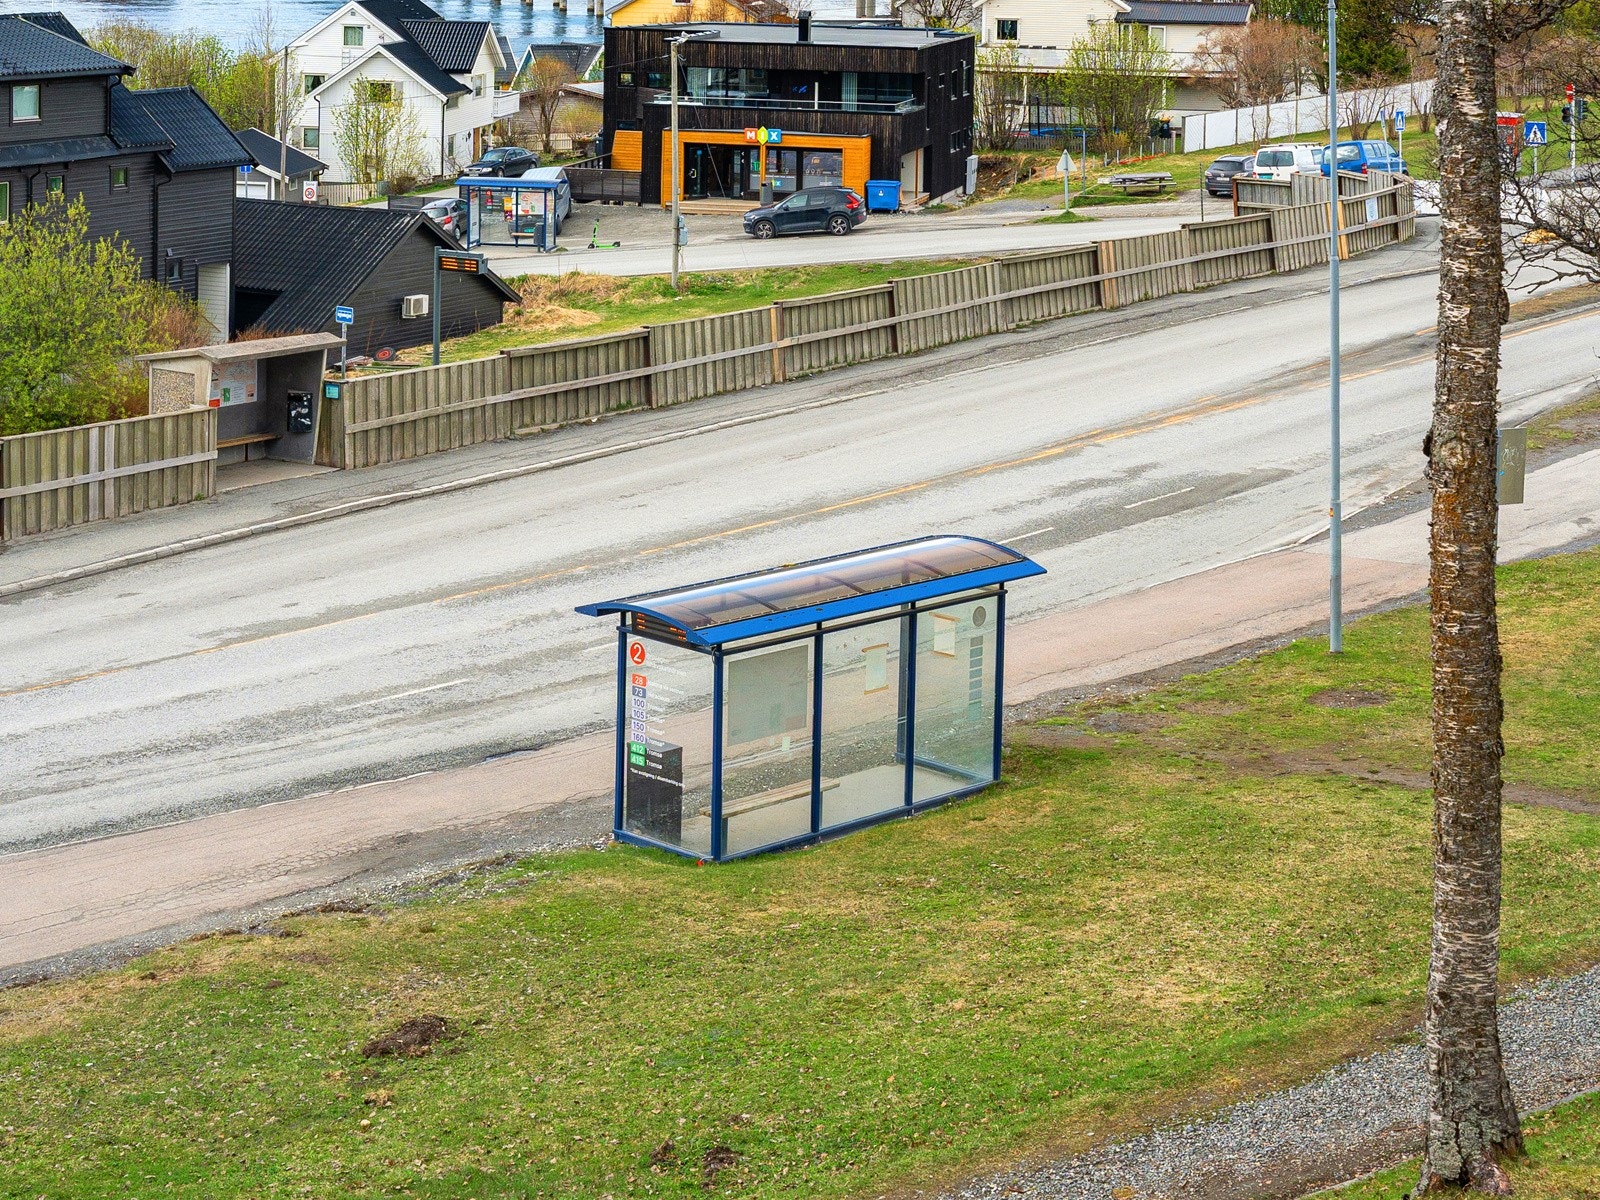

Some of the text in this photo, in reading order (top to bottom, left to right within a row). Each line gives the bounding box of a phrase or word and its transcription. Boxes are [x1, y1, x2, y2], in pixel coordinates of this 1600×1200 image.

[746, 130, 778, 141] MIX
[633, 644, 642, 662] 2
[634, 676, 644, 685] 28
[634, 687, 643, 697] 73
[633, 698, 645, 708] 100
[633, 709, 645, 719] 105
[633, 721, 645, 732] 150
[633, 732, 645, 743] 160
[631, 743, 643, 754] 412
[631, 755, 643, 766] 415
